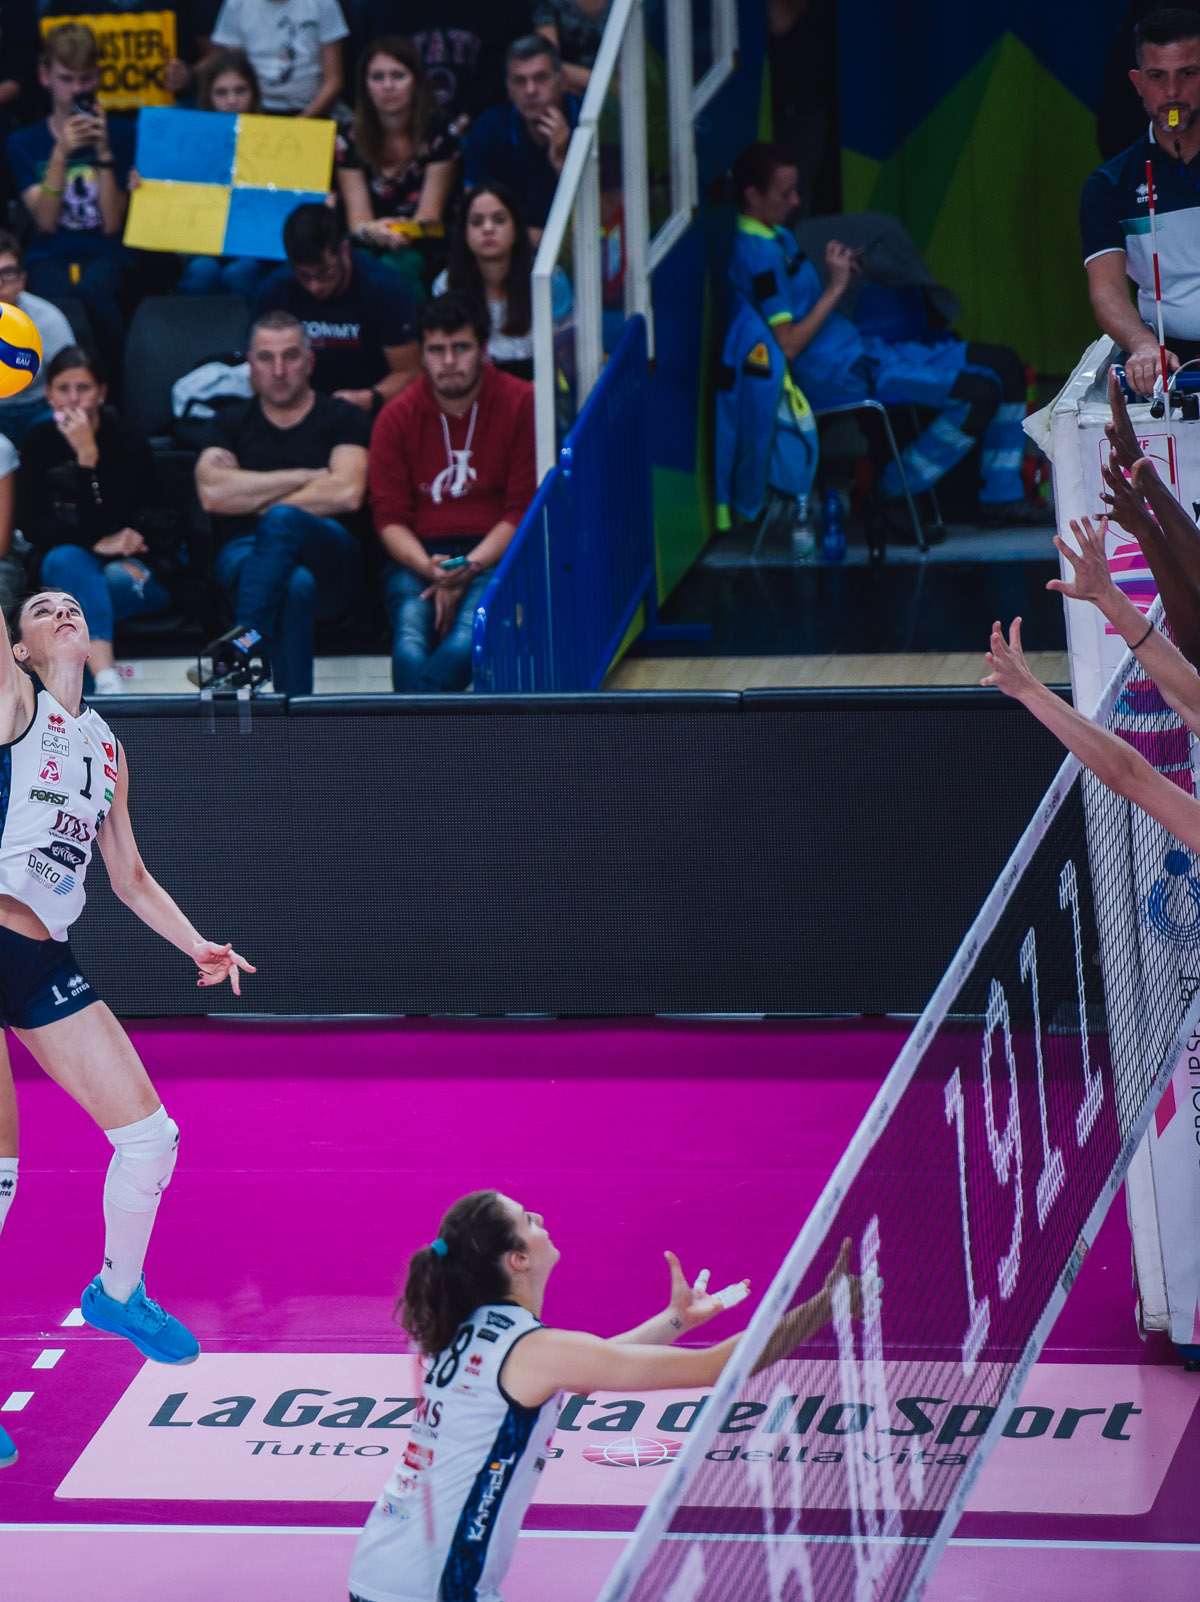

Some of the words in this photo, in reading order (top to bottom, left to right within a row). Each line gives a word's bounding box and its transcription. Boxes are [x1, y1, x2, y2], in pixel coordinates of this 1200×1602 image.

[99, 63, 165, 91] OCK
[1136, 193, 1158, 204] erra
[43, 739, 69, 753] CAVIT
[79, 756, 93, 800] 1
[29, 789, 70, 806] FORST
[27, 853, 62, 884] Delta
[148, 1391, 257, 1428] La
[656, 1393, 874, 1436] dello
[877, 1395, 1142, 1444] Sport
[245, 1440, 390, 1457] Tutto
[704, 1445, 844, 1464] della
